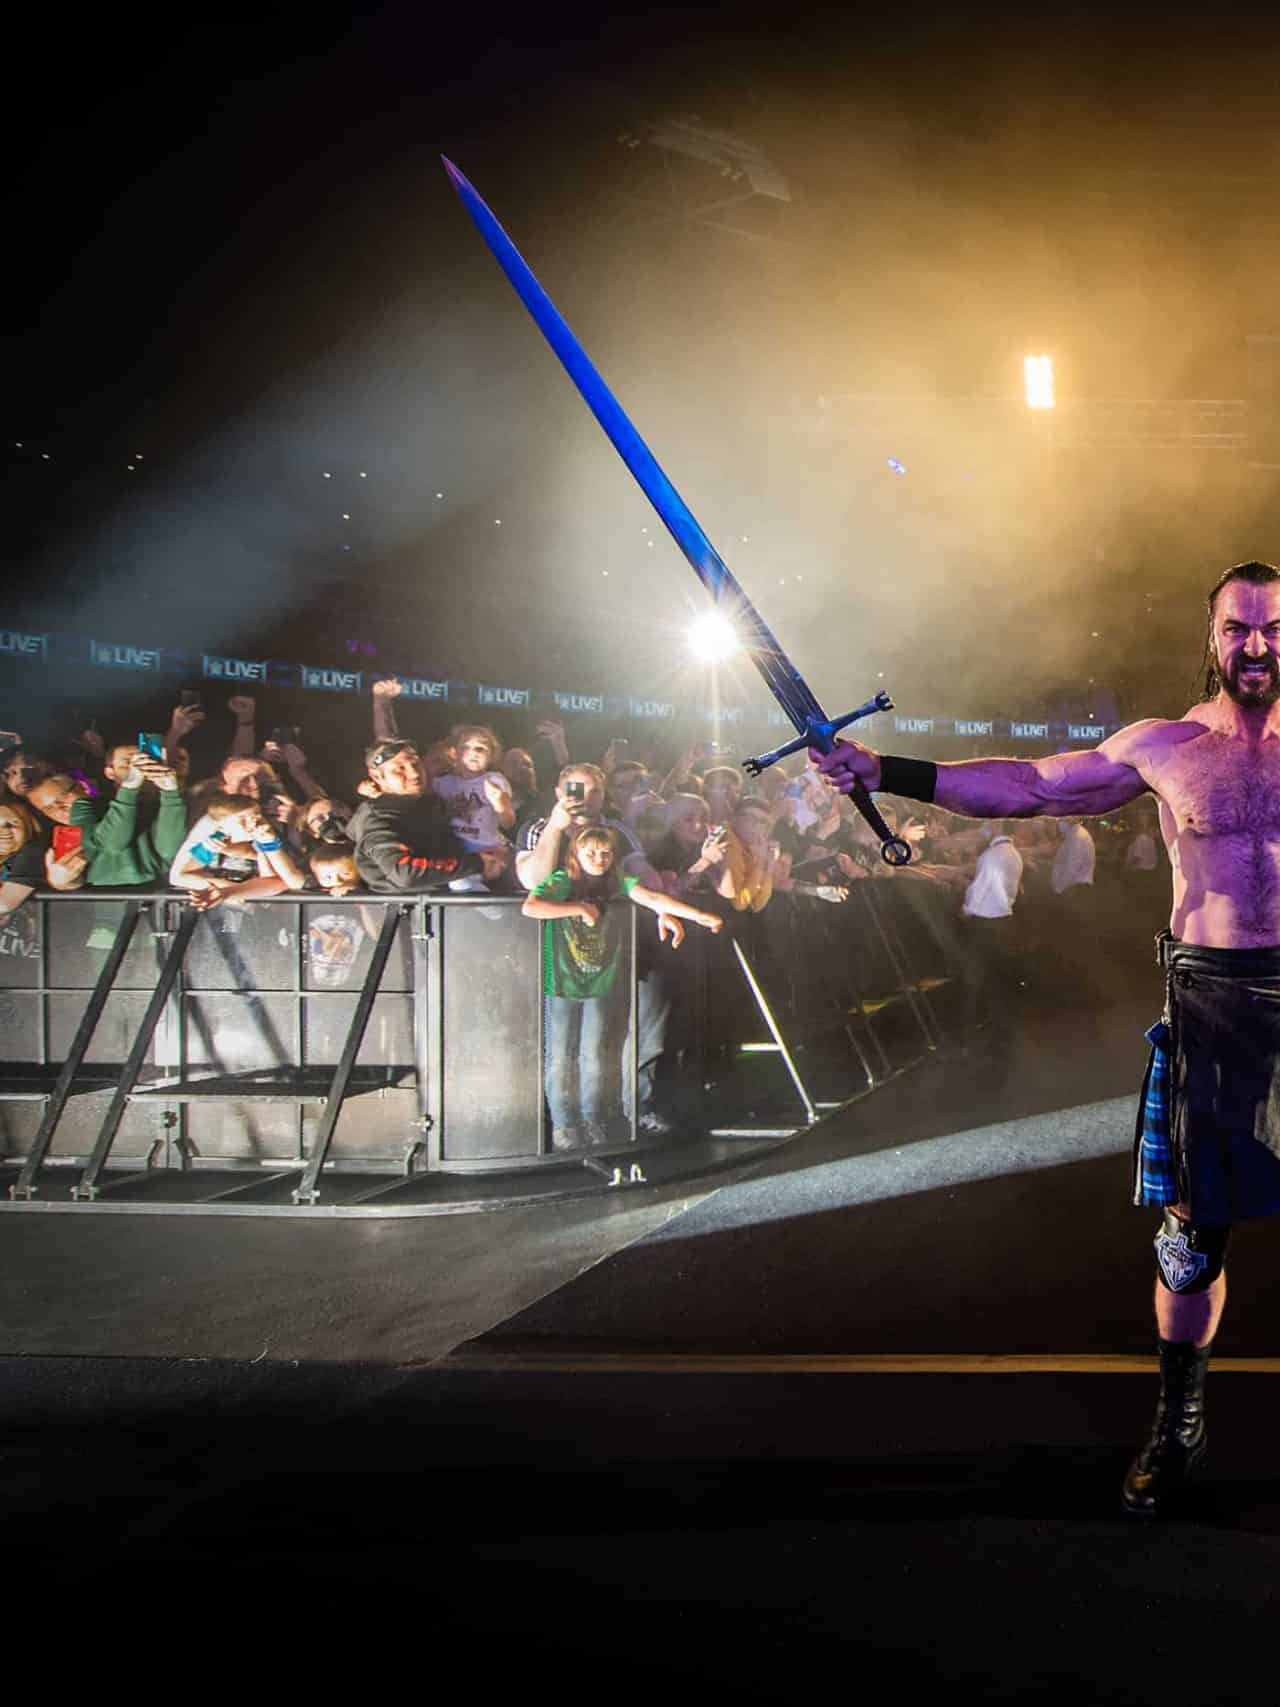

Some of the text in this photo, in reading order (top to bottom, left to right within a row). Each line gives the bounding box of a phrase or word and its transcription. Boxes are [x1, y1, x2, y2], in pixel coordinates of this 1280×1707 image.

[0, 633, 42, 654] LIVE
[115, 647, 156, 667] LIVE
[224, 660, 262, 679] LIVE
[322, 670, 357, 688] LIVE
[412, 680, 444, 697] LIVE
[495, 688, 526, 704] LIVE
[572, 695, 600, 712] LIVE
[908, 718, 929, 732] LIVE
[967, 721, 988, 734] LIVE
[1023, 723, 1044, 736] LIVE
[1080, 725, 1100, 737] LIVE
